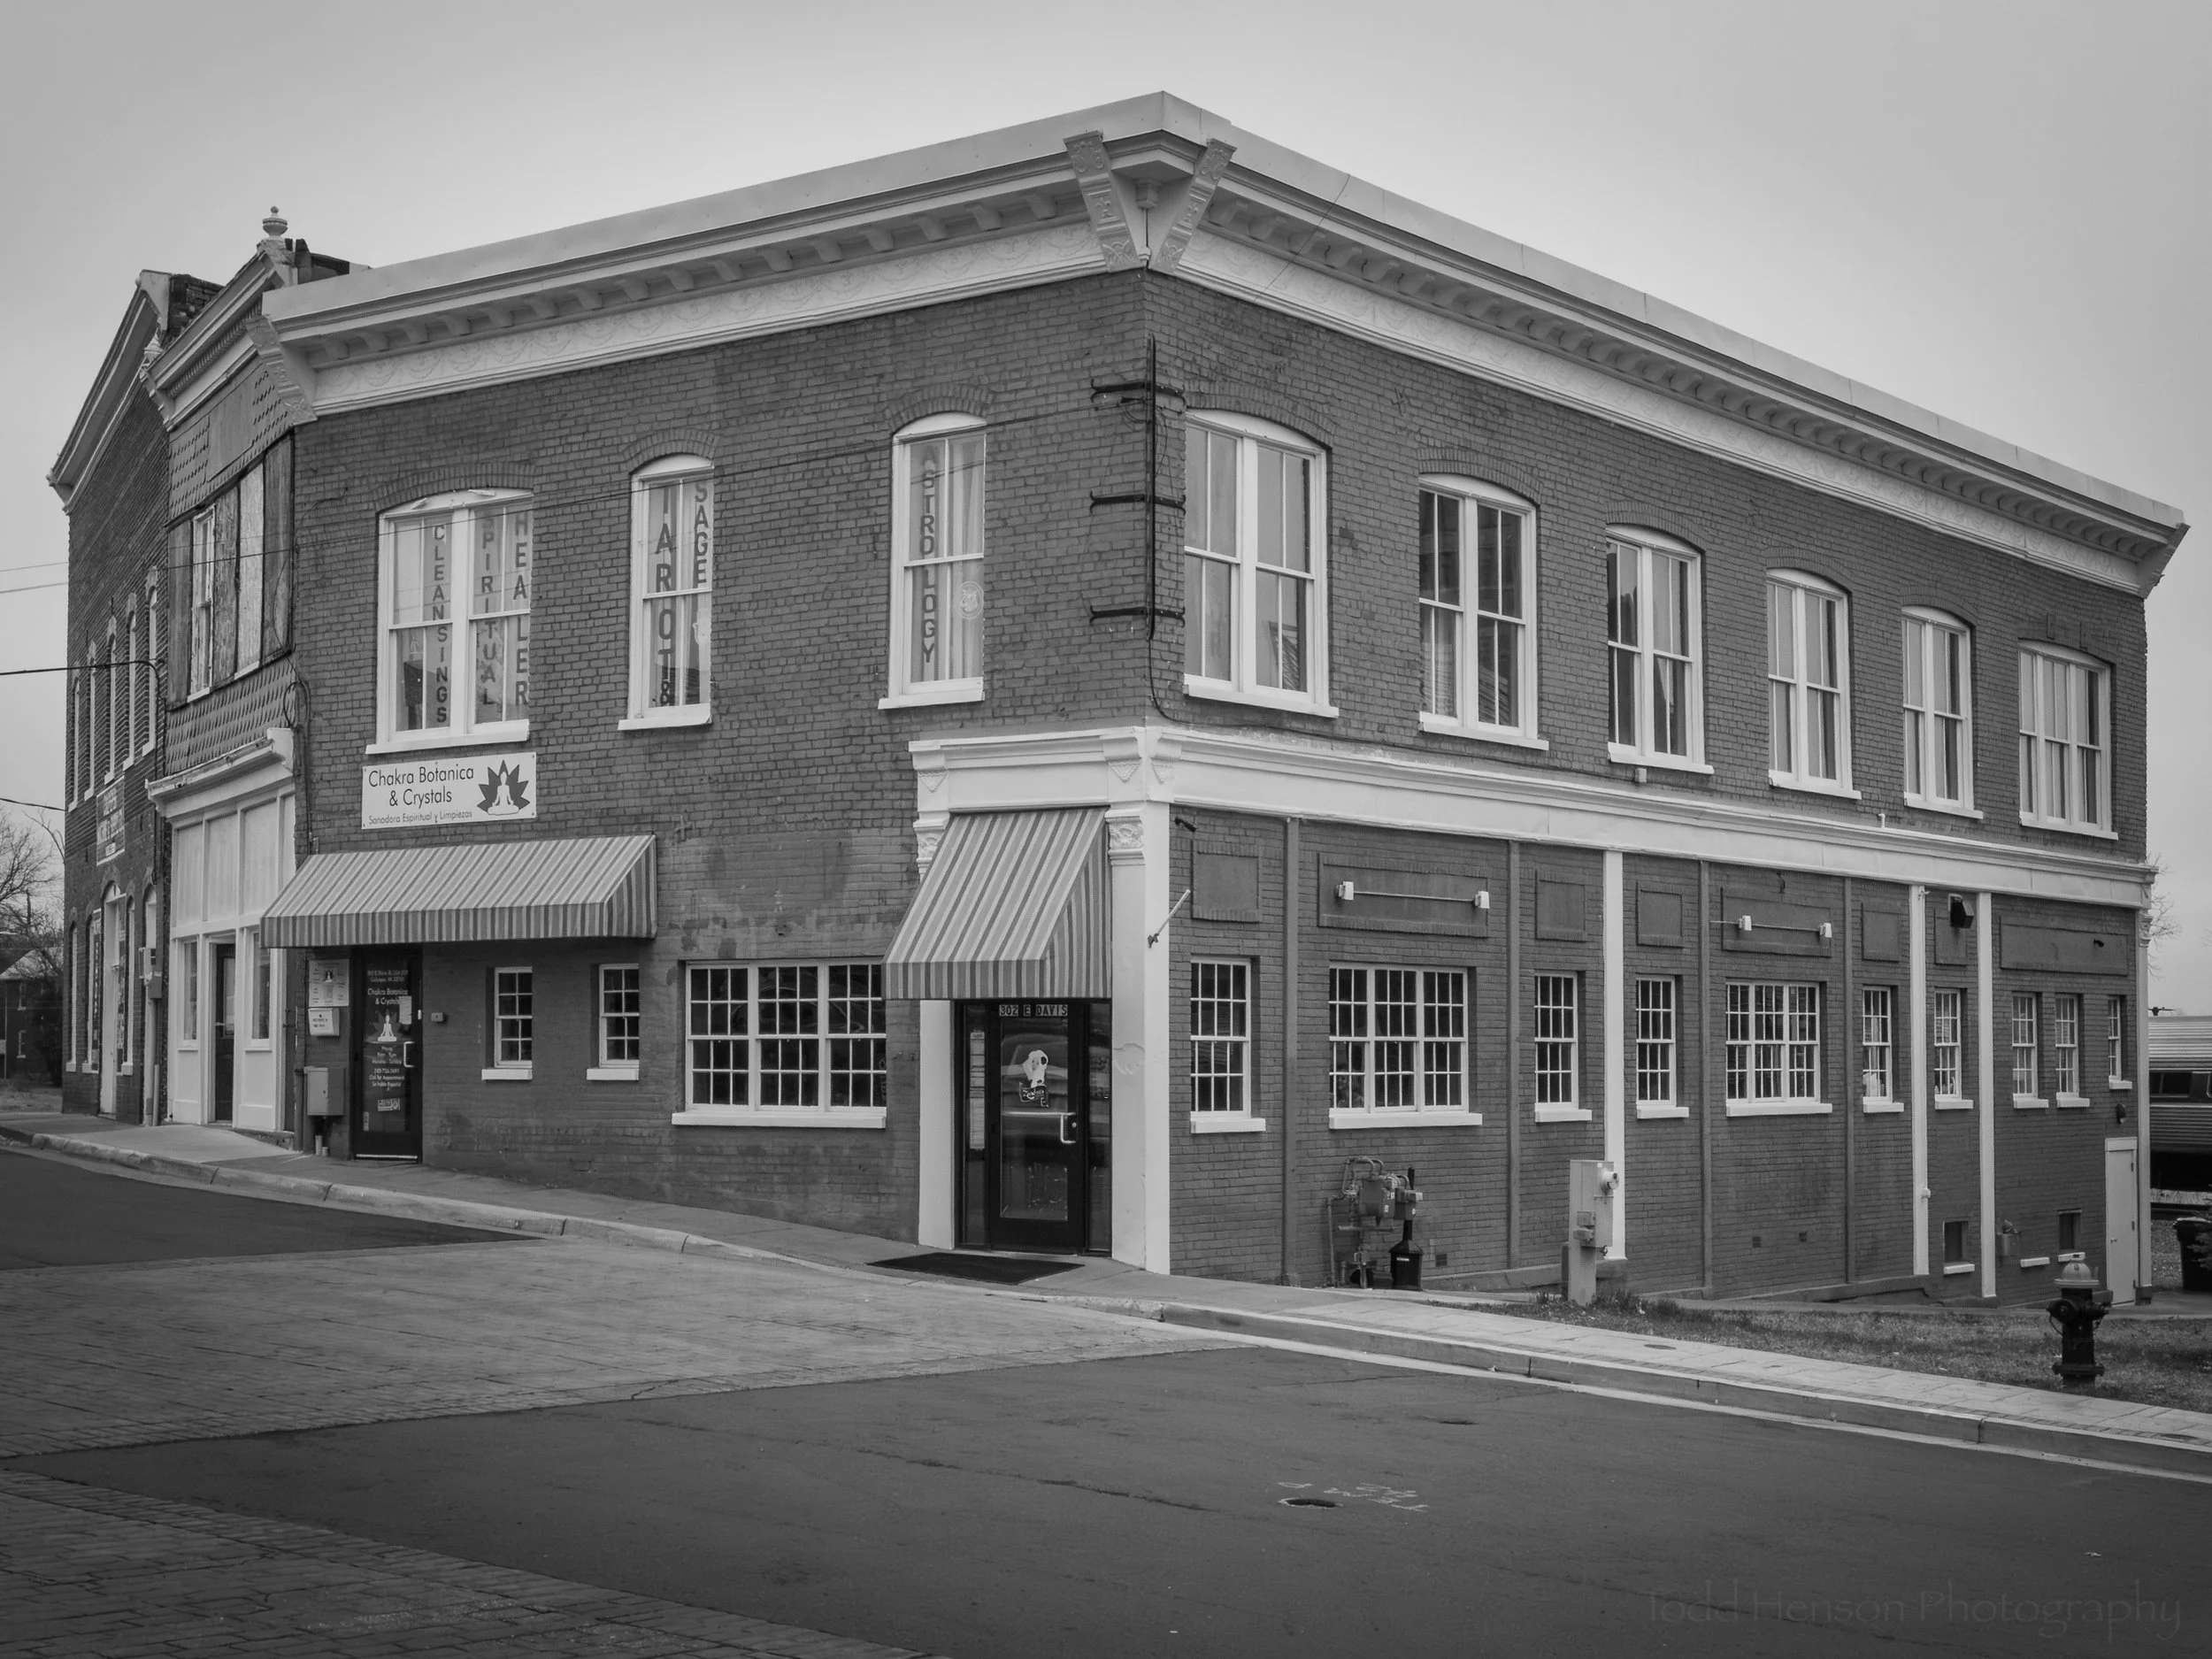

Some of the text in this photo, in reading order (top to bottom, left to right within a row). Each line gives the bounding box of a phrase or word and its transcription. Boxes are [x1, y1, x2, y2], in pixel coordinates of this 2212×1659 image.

[695, 481, 708, 584] SAGE
[919, 446, 937, 664] ASTROLOGY
[432, 525, 448, 724] CLEANSINGS
[481, 512, 496, 705] SPIRITUAL
[513, 511, 529, 706] HEALER
[368, 766, 474, 787] Chakra Botanica
[368, 814, 401, 825] Sanadora
[402, 811, 433, 823] Espiritual
[440, 810, 472, 820] Limpiezas
[388, 786, 452, 809] & Crystals
[1000, 1005, 1067, 1016] 302 E DAVIS
